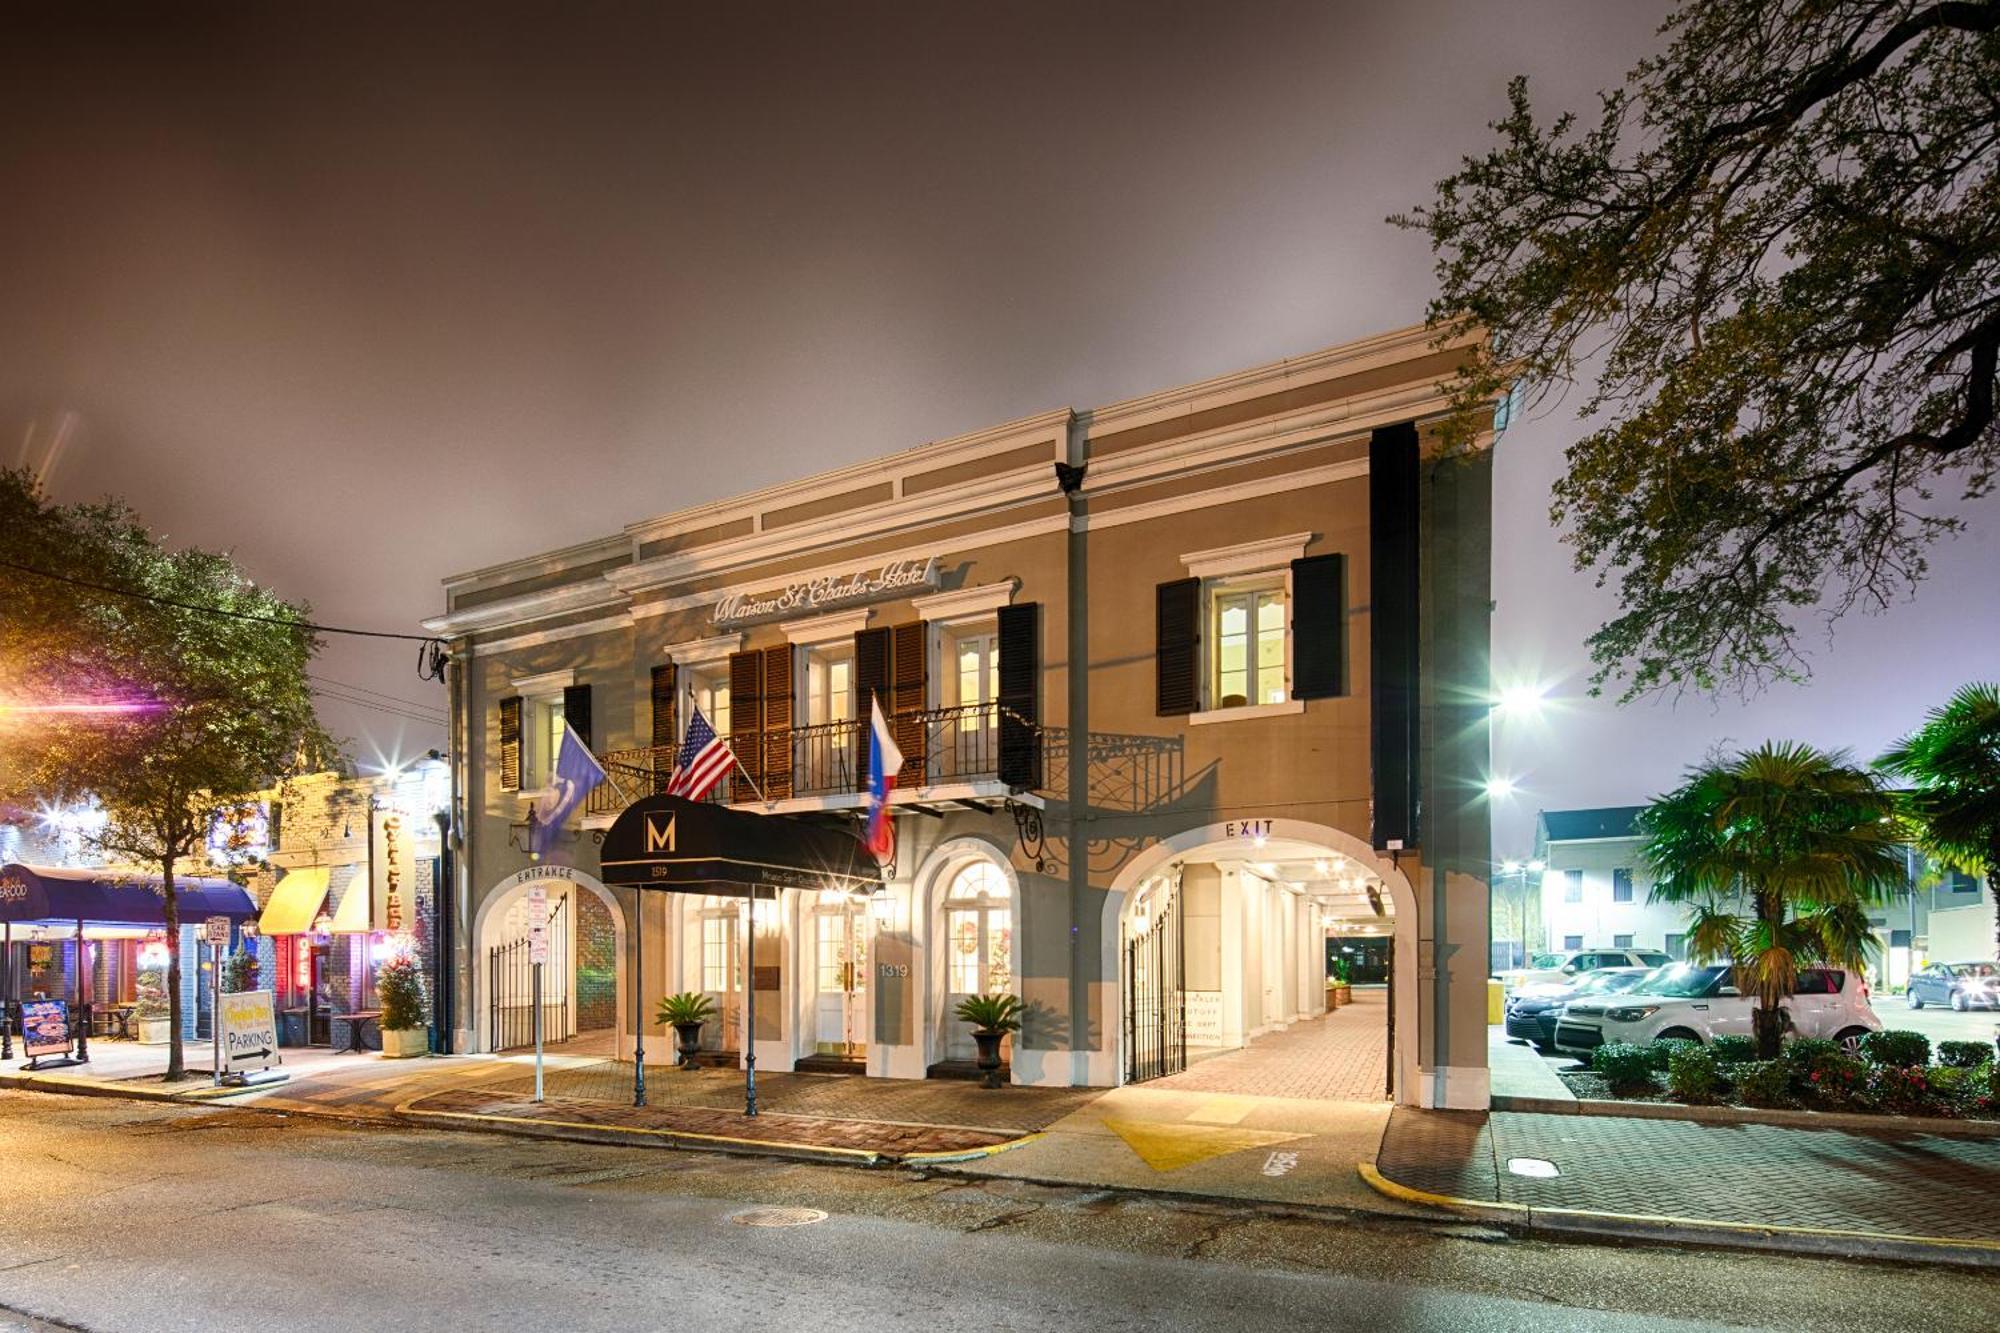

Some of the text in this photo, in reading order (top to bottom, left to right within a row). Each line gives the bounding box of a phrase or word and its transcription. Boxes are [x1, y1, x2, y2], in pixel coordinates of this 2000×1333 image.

[707, 595, 777, 624] Maison
[806, 572, 870, 603] Charles
[869, 556, 937, 591] Hotel
[647, 814, 676, 852] M
[1225, 820, 1273, 837] EXIT
[517, 866, 573, 882] ENTRANCE
[299, 938, 309, 986] OPEN
[881, 963, 908, 977] 1319
[229, 1030, 273, 1051] PARKING
